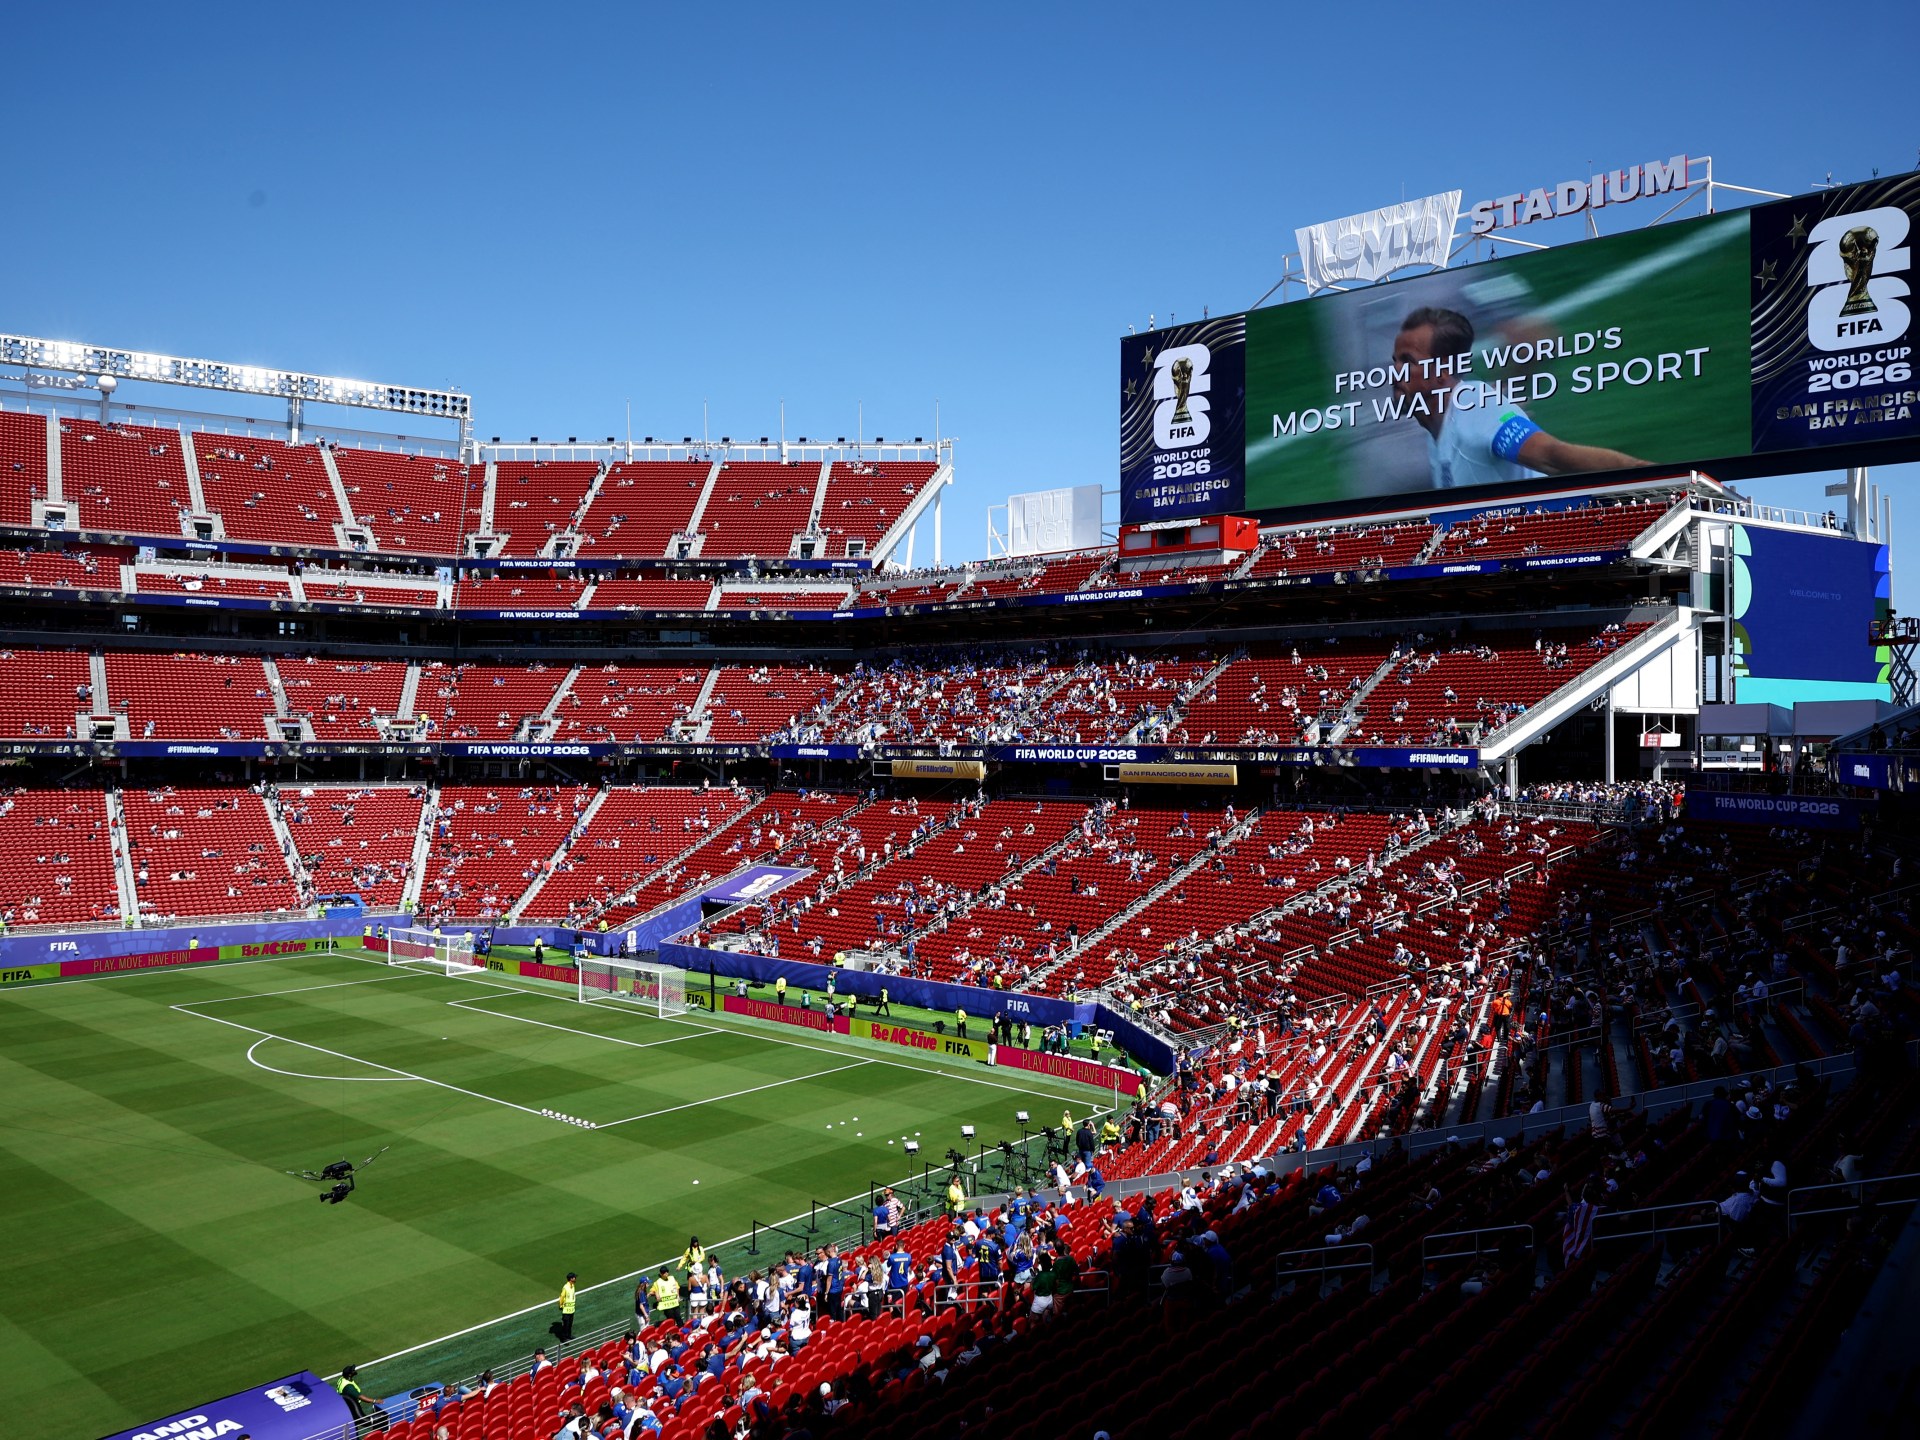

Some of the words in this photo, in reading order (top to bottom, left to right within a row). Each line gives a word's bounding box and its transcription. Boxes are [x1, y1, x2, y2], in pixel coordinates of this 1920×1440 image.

[1470, 154, 1688, 235] STADIUM
[1837, 318, 1883, 338] FIFA
[1335, 363, 1409, 394] FROM
[1419, 353, 1472, 381] THE
[1482, 327, 1622, 369] WORLD'S
[1808, 352, 1871, 371] WORLD
[1875, 346, 1911, 361] CUP
[1808, 362, 1912, 393] 2026
[1273, 401, 1361, 438] MOST
[1371, 373, 1557, 423] WATCHED
[1571, 347, 1710, 394] SPORT
[1776, 402, 1817, 420] SAN
[1809, 413, 1848, 431] BAY
[1854, 406, 1911, 425] AREA
[1170, 426, 1195, 440] FIFA
[1154, 451, 1188, 464] WORLD
[1190, 448, 1211, 459] CUP
[1153, 460, 1211, 480] 2026
[1135, 487, 1159, 499] SAN
[1161, 479, 1230, 497] FRANCISCO
[1153, 496, 1175, 508] BAY
[1178, 492, 1210, 504] AREA
[1541, 558, 1564, 566] WORLD
[1578, 555, 1602, 563] 2026
[1065, 594, 1078, 602] FIFA
[1078, 593, 1103, 601] WORLD
[1104, 591, 1117, 599] CUP
[1118, 589, 1143, 598] 2026
[1789, 588, 1830, 600] WELCOME
[1830, 593, 1842, 601] TO
[13, 745, 37, 754] BAY
[167, 746, 218, 755] #FIFAWorldCup
[306, 746, 326, 754] SAN
[386, 746, 404, 754] BAY
[467, 746, 490, 754] FIFA
[491, 746, 529, 754] WORLD
[530, 746, 552, 754] CUP
[552, 746, 590, 754] 2026
[624, 747, 643, 755] SAN
[696, 747, 714, 755] BAY
[886, 749, 902, 757] SAN
[1015, 749, 1036, 760] FIFA
[1037, 749, 1075, 760] WORLD
[1076, 749, 1097, 760] CUP
[1098, 749, 1137, 760] 2026
[1173, 751, 1195, 761] SAN
[1257, 751, 1278, 761] BAY
[1409, 753, 1469, 766] #FIFAWorldCup
[915, 764, 954, 774] #FIFAWorldCup
[1714, 797, 1737, 810] FIFA
[1738, 798, 1775, 811] WORLD
[1776, 800, 1798, 812] CUP
[1799, 801, 1840, 815] 2026
[50, 941, 78, 952] FIFA
[582, 937, 596, 947] FIFA
[242, 945, 260, 956] Be
[93, 960, 116, 972] PLAY.
[118, 957, 146, 969] MOVE.
[148, 954, 169, 966] HAVE
[171, 951, 191, 964] FUN!
[489, 960, 504, 971] FIFA
[2, 969, 32, 982] FIFA
[686, 993, 705, 1006] FIFA
[1006, 1000, 1030, 1013] FIFA
[747, 1001, 763, 1017] PLAY.
[765, 1005, 787, 1021] MOVE.
[788, 1009, 806, 1025] HAVE
[807, 1012, 825, 1028] FUN!
[871, 1022, 889, 1041] Be
[945, 1040, 971, 1057] FIFA
[1022, 1052, 1045, 1072] PLAY.
[1047, 1058, 1075, 1078] MOVE.
[1077, 1064, 1100, 1084] HAVE
[1102, 1069, 1123, 1090] FUN!
[898, 1262, 905, 1275] 4
[421, 1397, 437, 1408] 136
[132, 1414, 209, 1440] AND
